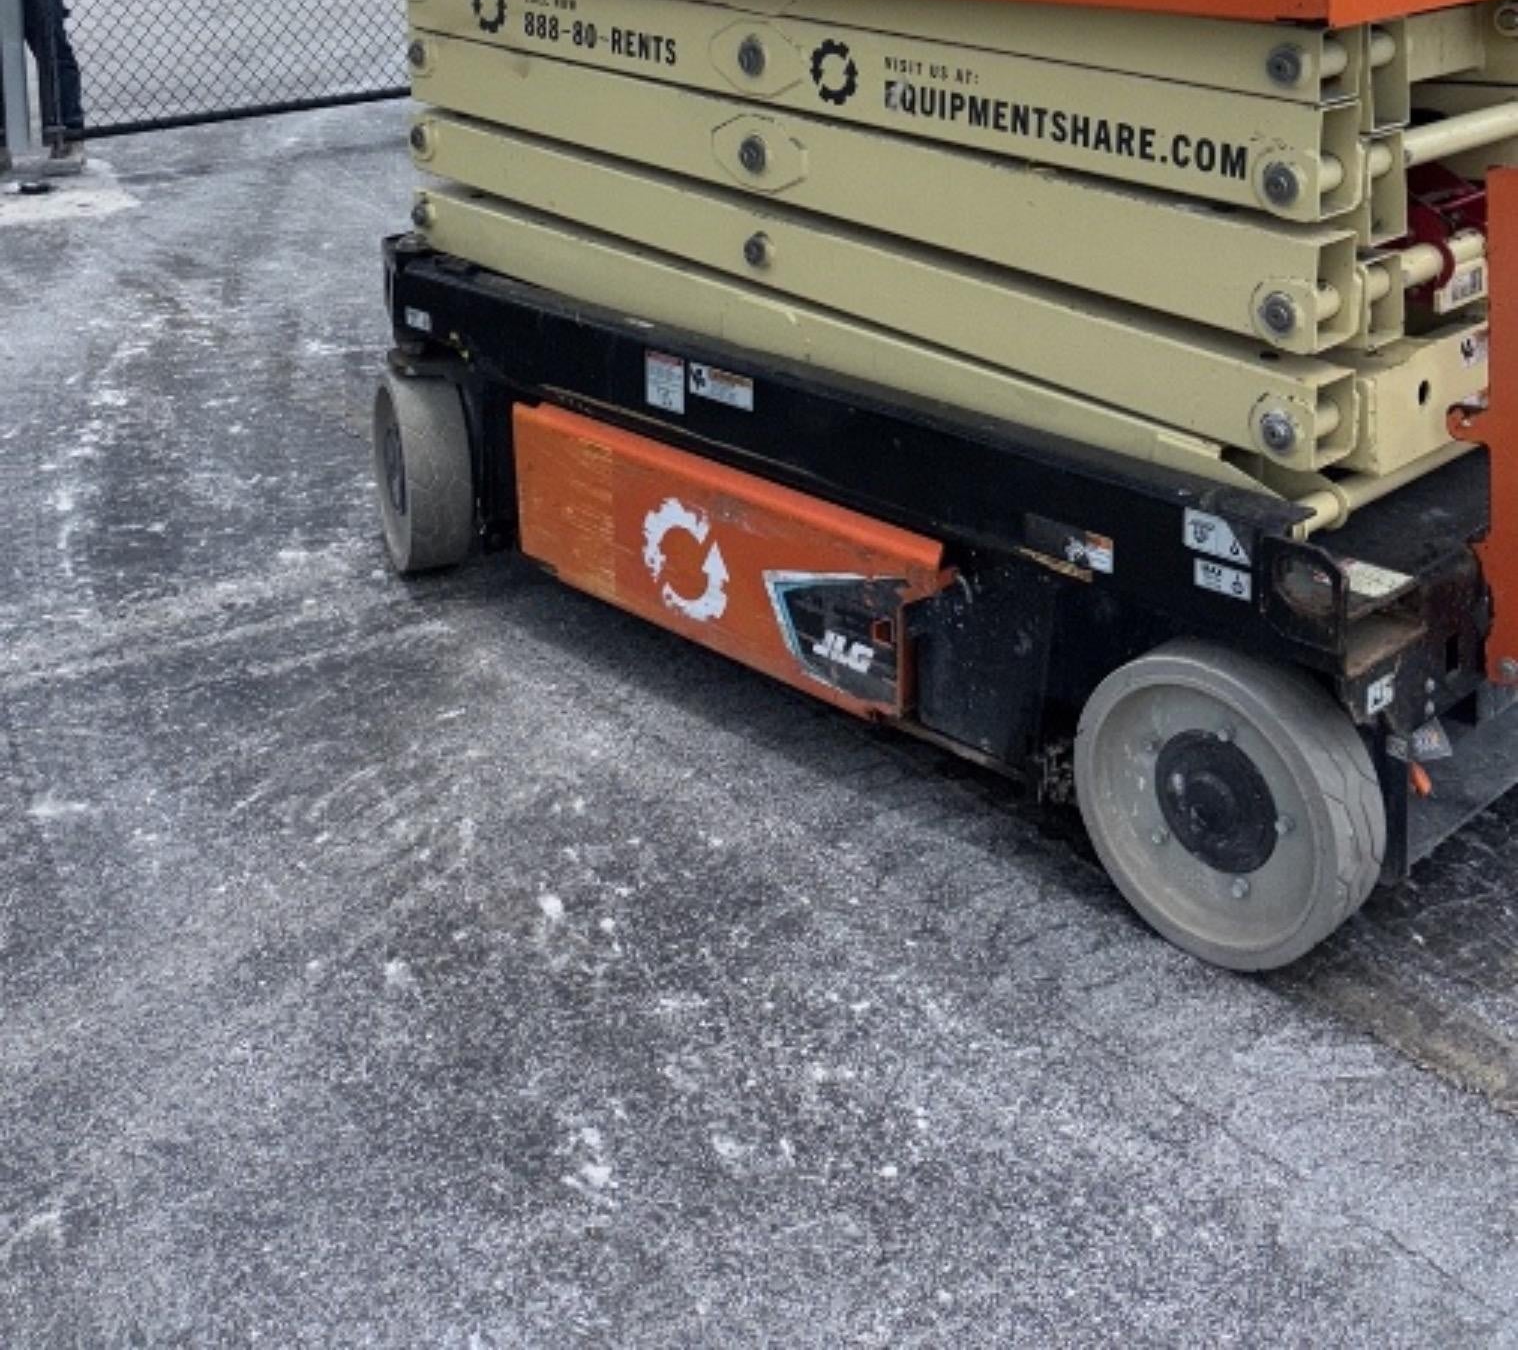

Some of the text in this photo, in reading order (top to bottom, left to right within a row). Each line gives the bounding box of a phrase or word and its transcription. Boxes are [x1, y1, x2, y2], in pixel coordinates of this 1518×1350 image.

[523, 11, 677, 65] 888-80-RENTS
[884, 56, 922, 75] VISIT
[929, 64, 948, 81] US
[884, 79, 1248, 181] EQUIPMENTSHARE.COM
[812, 630, 875, 674] JLG
